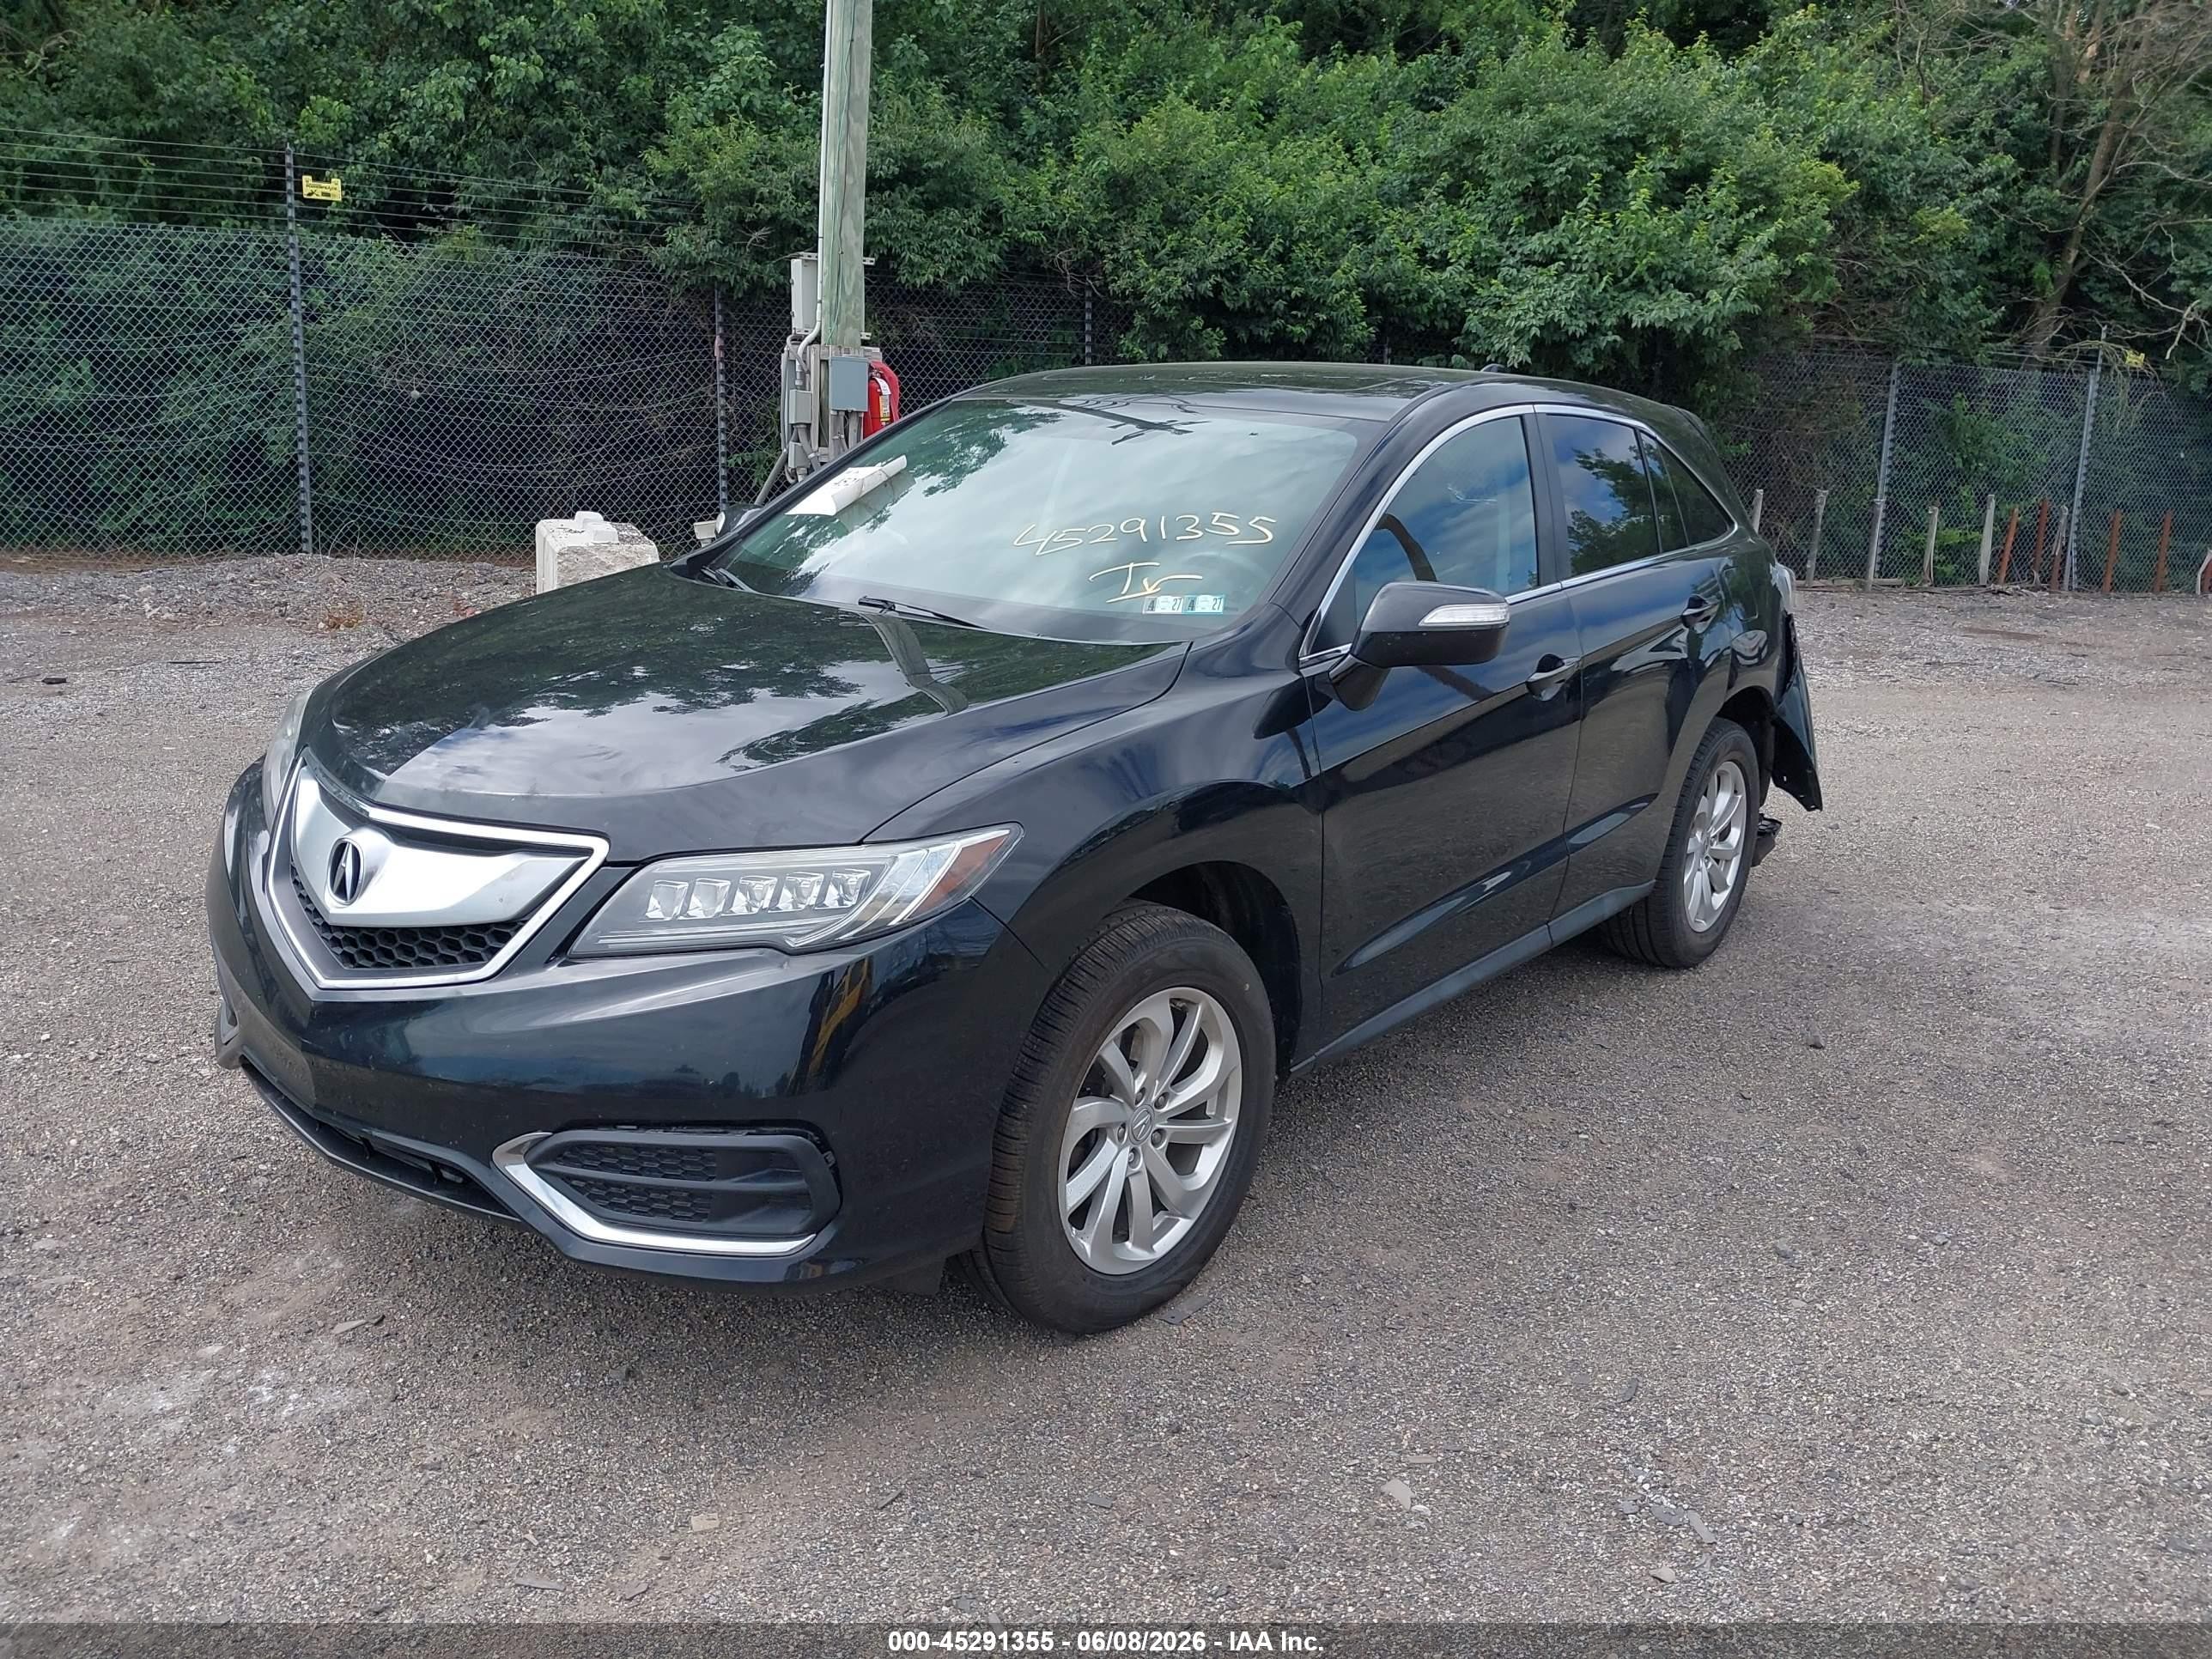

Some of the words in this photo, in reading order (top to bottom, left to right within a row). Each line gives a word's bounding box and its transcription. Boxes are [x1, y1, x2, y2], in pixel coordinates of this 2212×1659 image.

[1013, 512, 1278, 556] 45291355
[1171, 598, 1182, 611] 27
[1212, 597, 1223, 611] 27
